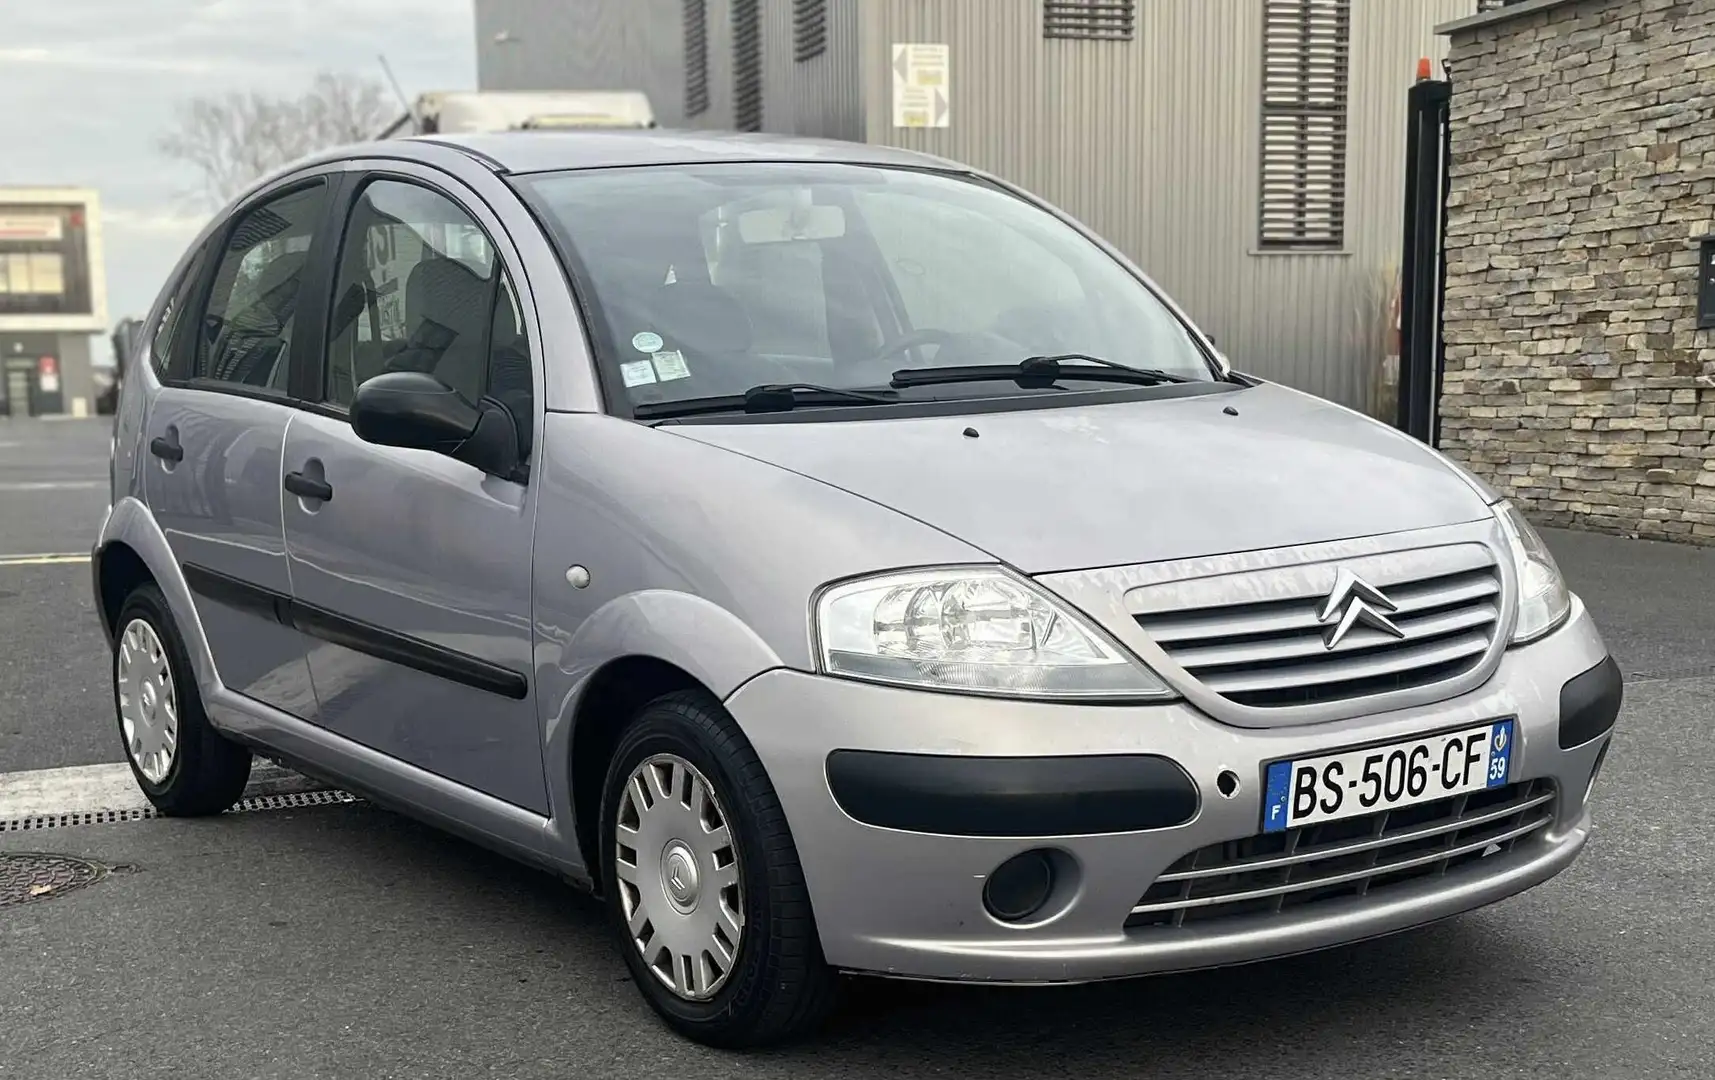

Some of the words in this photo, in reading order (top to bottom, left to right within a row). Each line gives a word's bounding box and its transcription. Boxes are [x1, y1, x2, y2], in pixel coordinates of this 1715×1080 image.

[1293, 732, 1487, 820] BS-506-CF
[1489, 756, 1506, 780] 59
[1271, 804, 1281, 820] F
